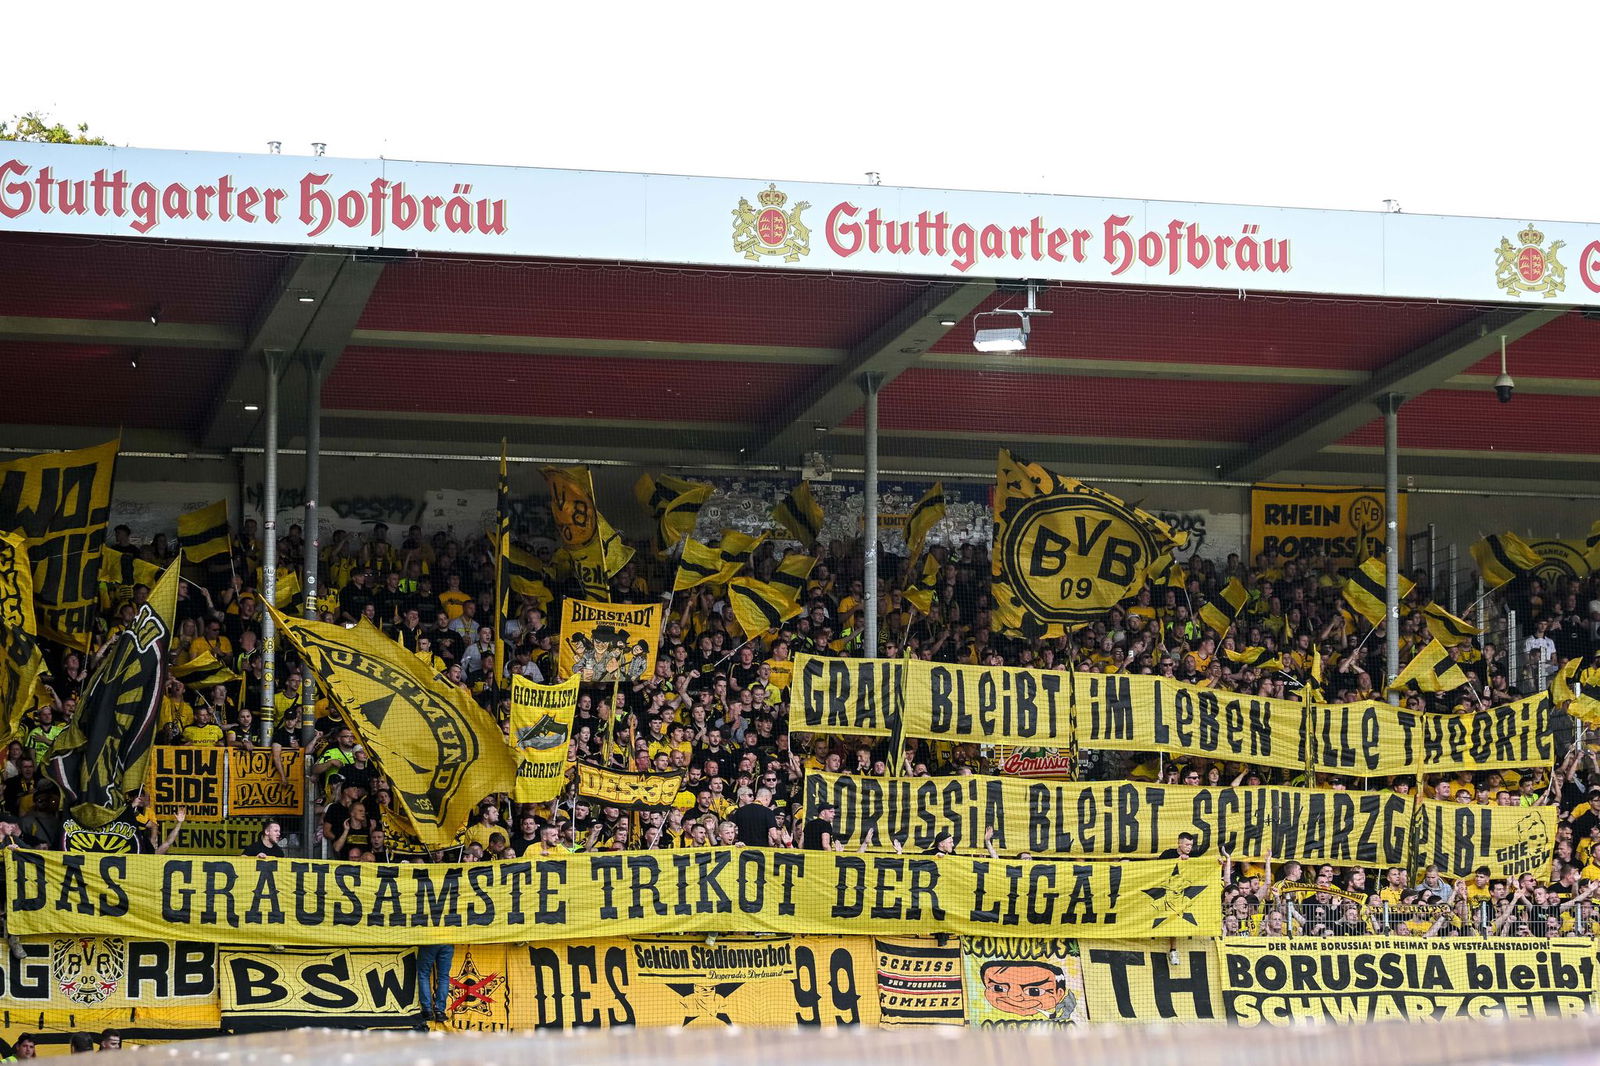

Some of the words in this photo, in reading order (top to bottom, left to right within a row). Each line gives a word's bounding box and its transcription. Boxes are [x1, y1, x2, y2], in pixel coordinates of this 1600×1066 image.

[0, 160, 287, 234] Stuttgarter
[298, 172, 508, 237] Hofbräu
[825, 201, 1091, 272] Stuttgarter
[1103, 214, 1292, 276] Hofbräu
[1264, 504, 1341, 526] RHEIN
[1030, 517, 1142, 587] BVB
[1060, 577, 1093, 600] 09
[571, 601, 654, 628] BIERSTADT
[513, 686, 578, 709] GIORNALISTA
[156, 749, 218, 775] LOW
[155, 777, 218, 803] SIDE
[12, 851, 129, 917] DAS
[161, 860, 567, 928] GRAUSAMSTE
[590, 849, 805, 920] TRIKOT
[831, 856, 946, 922] DER
[969, 860, 1123, 926] LIGA!
[633, 944, 690, 969] Sektion
[690, 943, 792, 969] Stadionverbot
[1268, 942, 1287, 951] DER
[1290, 942, 1318, 950] NAME
[1321, 941, 1372, 950] BORUSSIA!
[1375, 941, 1391, 949] DIE
[1394, 941, 1429, 950] HEIMAT
[1432, 942, 1451, 950] DAS
[1453, 941, 1550, 951] WESTFALENSTADION!
[0, 943, 50, 999] G
[127, 941, 216, 998] RB
[880, 955, 954, 972] SCHEISS
[1226, 952, 1454, 991] BORUSSIA
[1465, 951, 1595, 990] bleibt
[81, 975, 96, 985] 09
[229, 950, 417, 1011] BSW
[529, 945, 636, 1030] DES
[791, 945, 861, 1028] 99
[880, 993, 961, 1008] KOMMERZ
